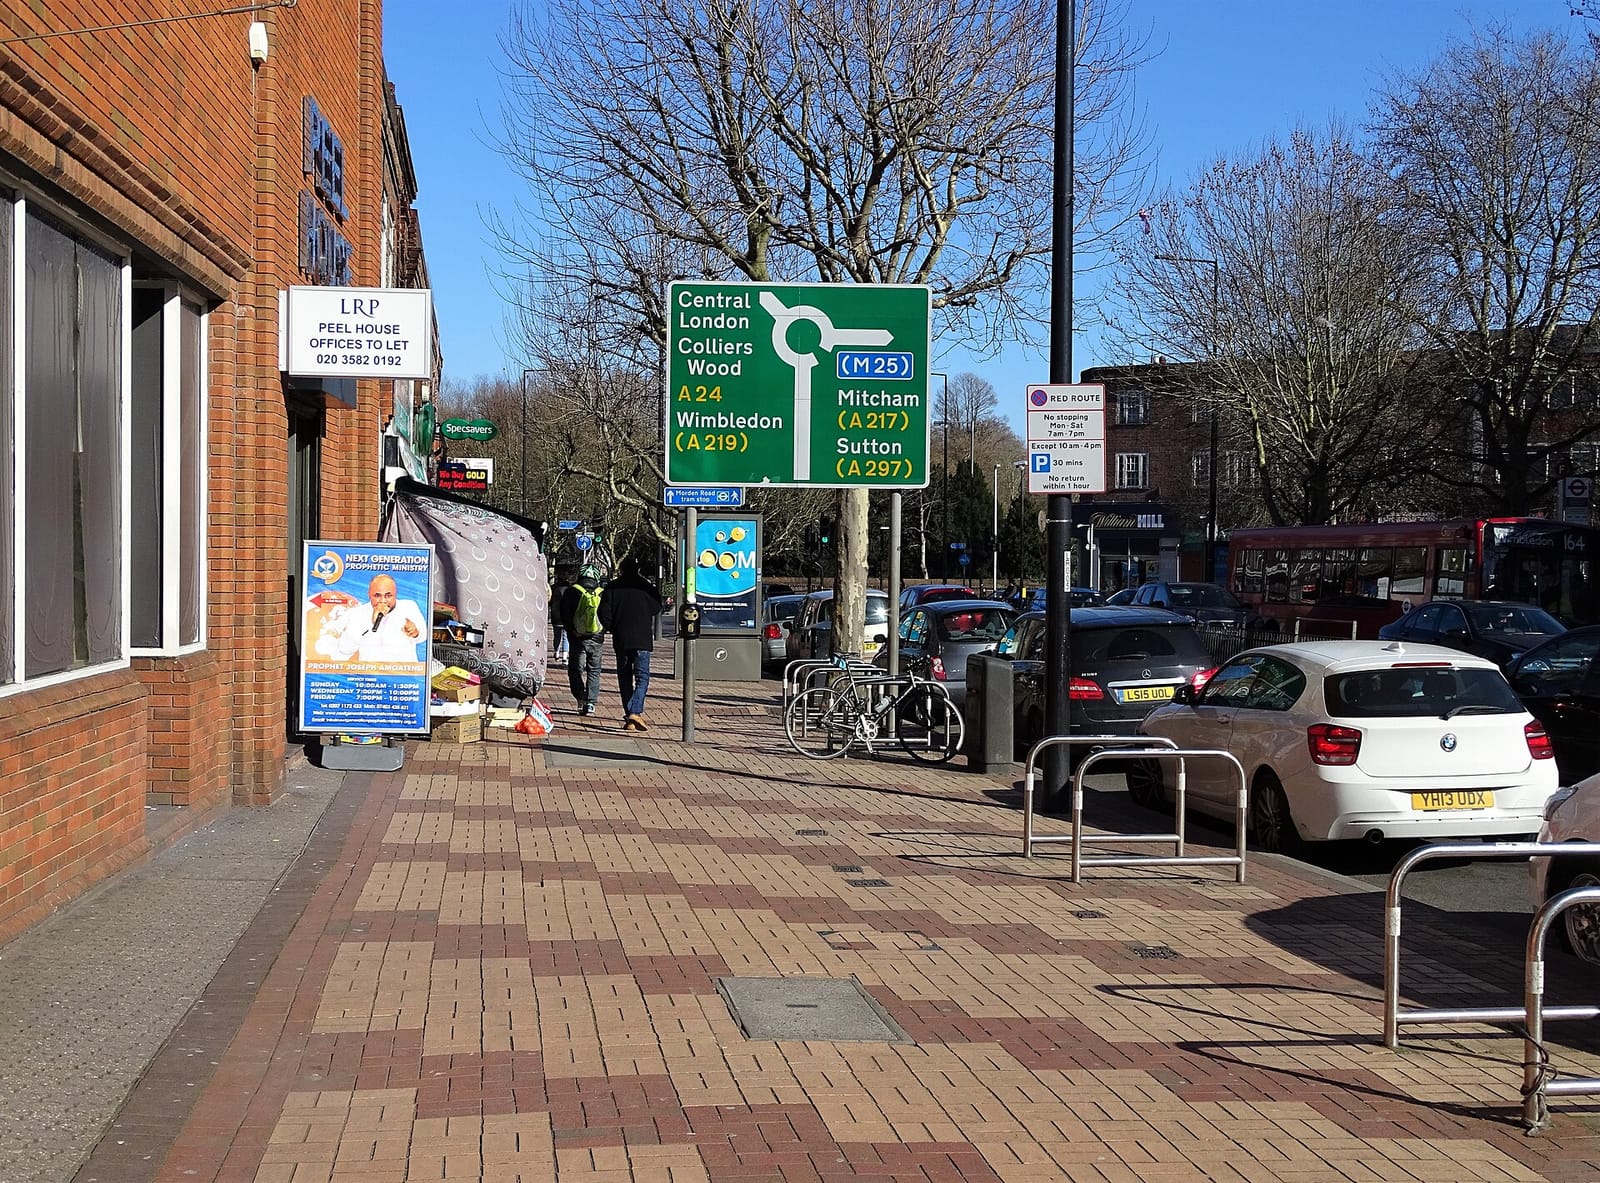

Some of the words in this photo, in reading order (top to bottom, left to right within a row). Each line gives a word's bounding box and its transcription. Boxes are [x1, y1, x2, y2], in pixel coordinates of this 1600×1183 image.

[678, 291, 751, 309] Central
[341, 298, 380, 318] LRP
[680, 312, 749, 329] London
[319, 323, 352, 333] PEEL
[356, 324, 400, 335] HOUSE
[310, 338, 362, 349] OFFICES
[366, 339, 382, 349] TO
[387, 340, 409, 350] LET
[678, 337, 753, 355] Colliers
[317, 354, 337, 364] 020
[342, 355, 369, 365] 3582
[373, 356, 401, 366] 0192
[687, 359, 742, 376] Wood
[837, 389, 919, 407] Mitcham
[677, 412, 783, 429] Wimbledon
[446, 424, 492, 434] Specsavers
[837, 438, 902, 455] Sutton
[1036, 456, 1048, 471] P
[452, 471, 464, 480] Buy
[466, 471, 485, 479] GOLD
[439, 480, 452, 489] Any
[1137, 514, 1164, 528] HILL
[1564, 534, 1585, 550] 164
[346, 554, 369, 562] NEXT
[371, 555, 428, 564] GENERATION
[1128, 689, 1149, 700] LS15
[1421, 792, 1453, 806] YH13
[1458, 792, 1485, 805] UDX
